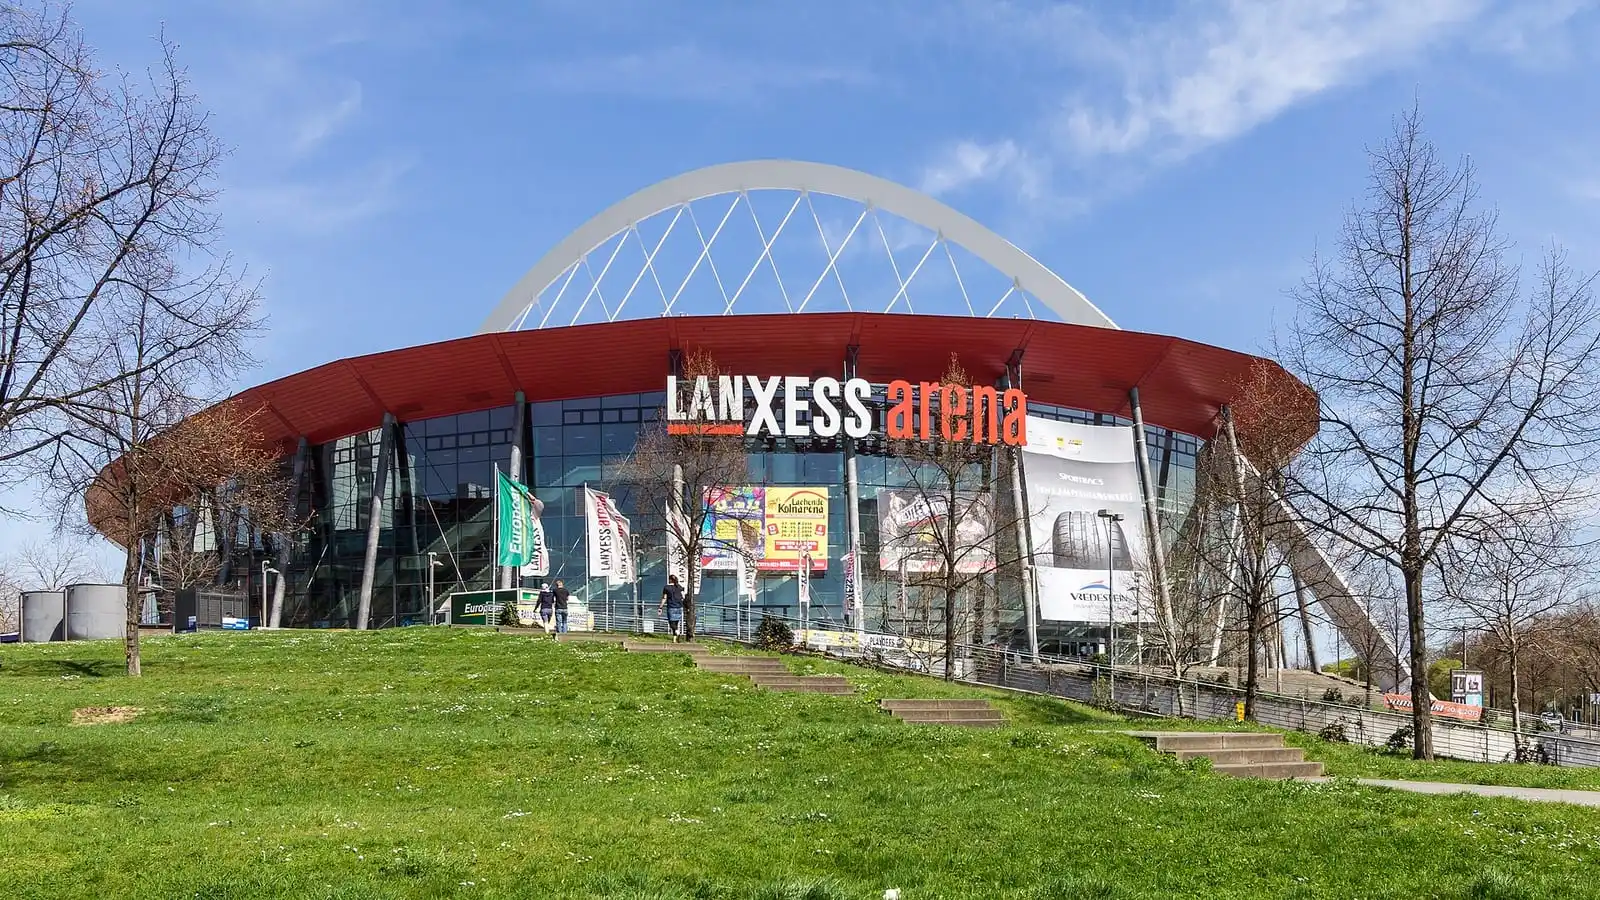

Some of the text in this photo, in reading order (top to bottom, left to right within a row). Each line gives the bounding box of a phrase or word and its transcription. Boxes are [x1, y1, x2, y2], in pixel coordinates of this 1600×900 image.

[666, 375, 1027, 446] LANXESS arena
[599, 528, 612, 571] LANXESS
[1070, 592, 1128, 602] VREDESEIN
